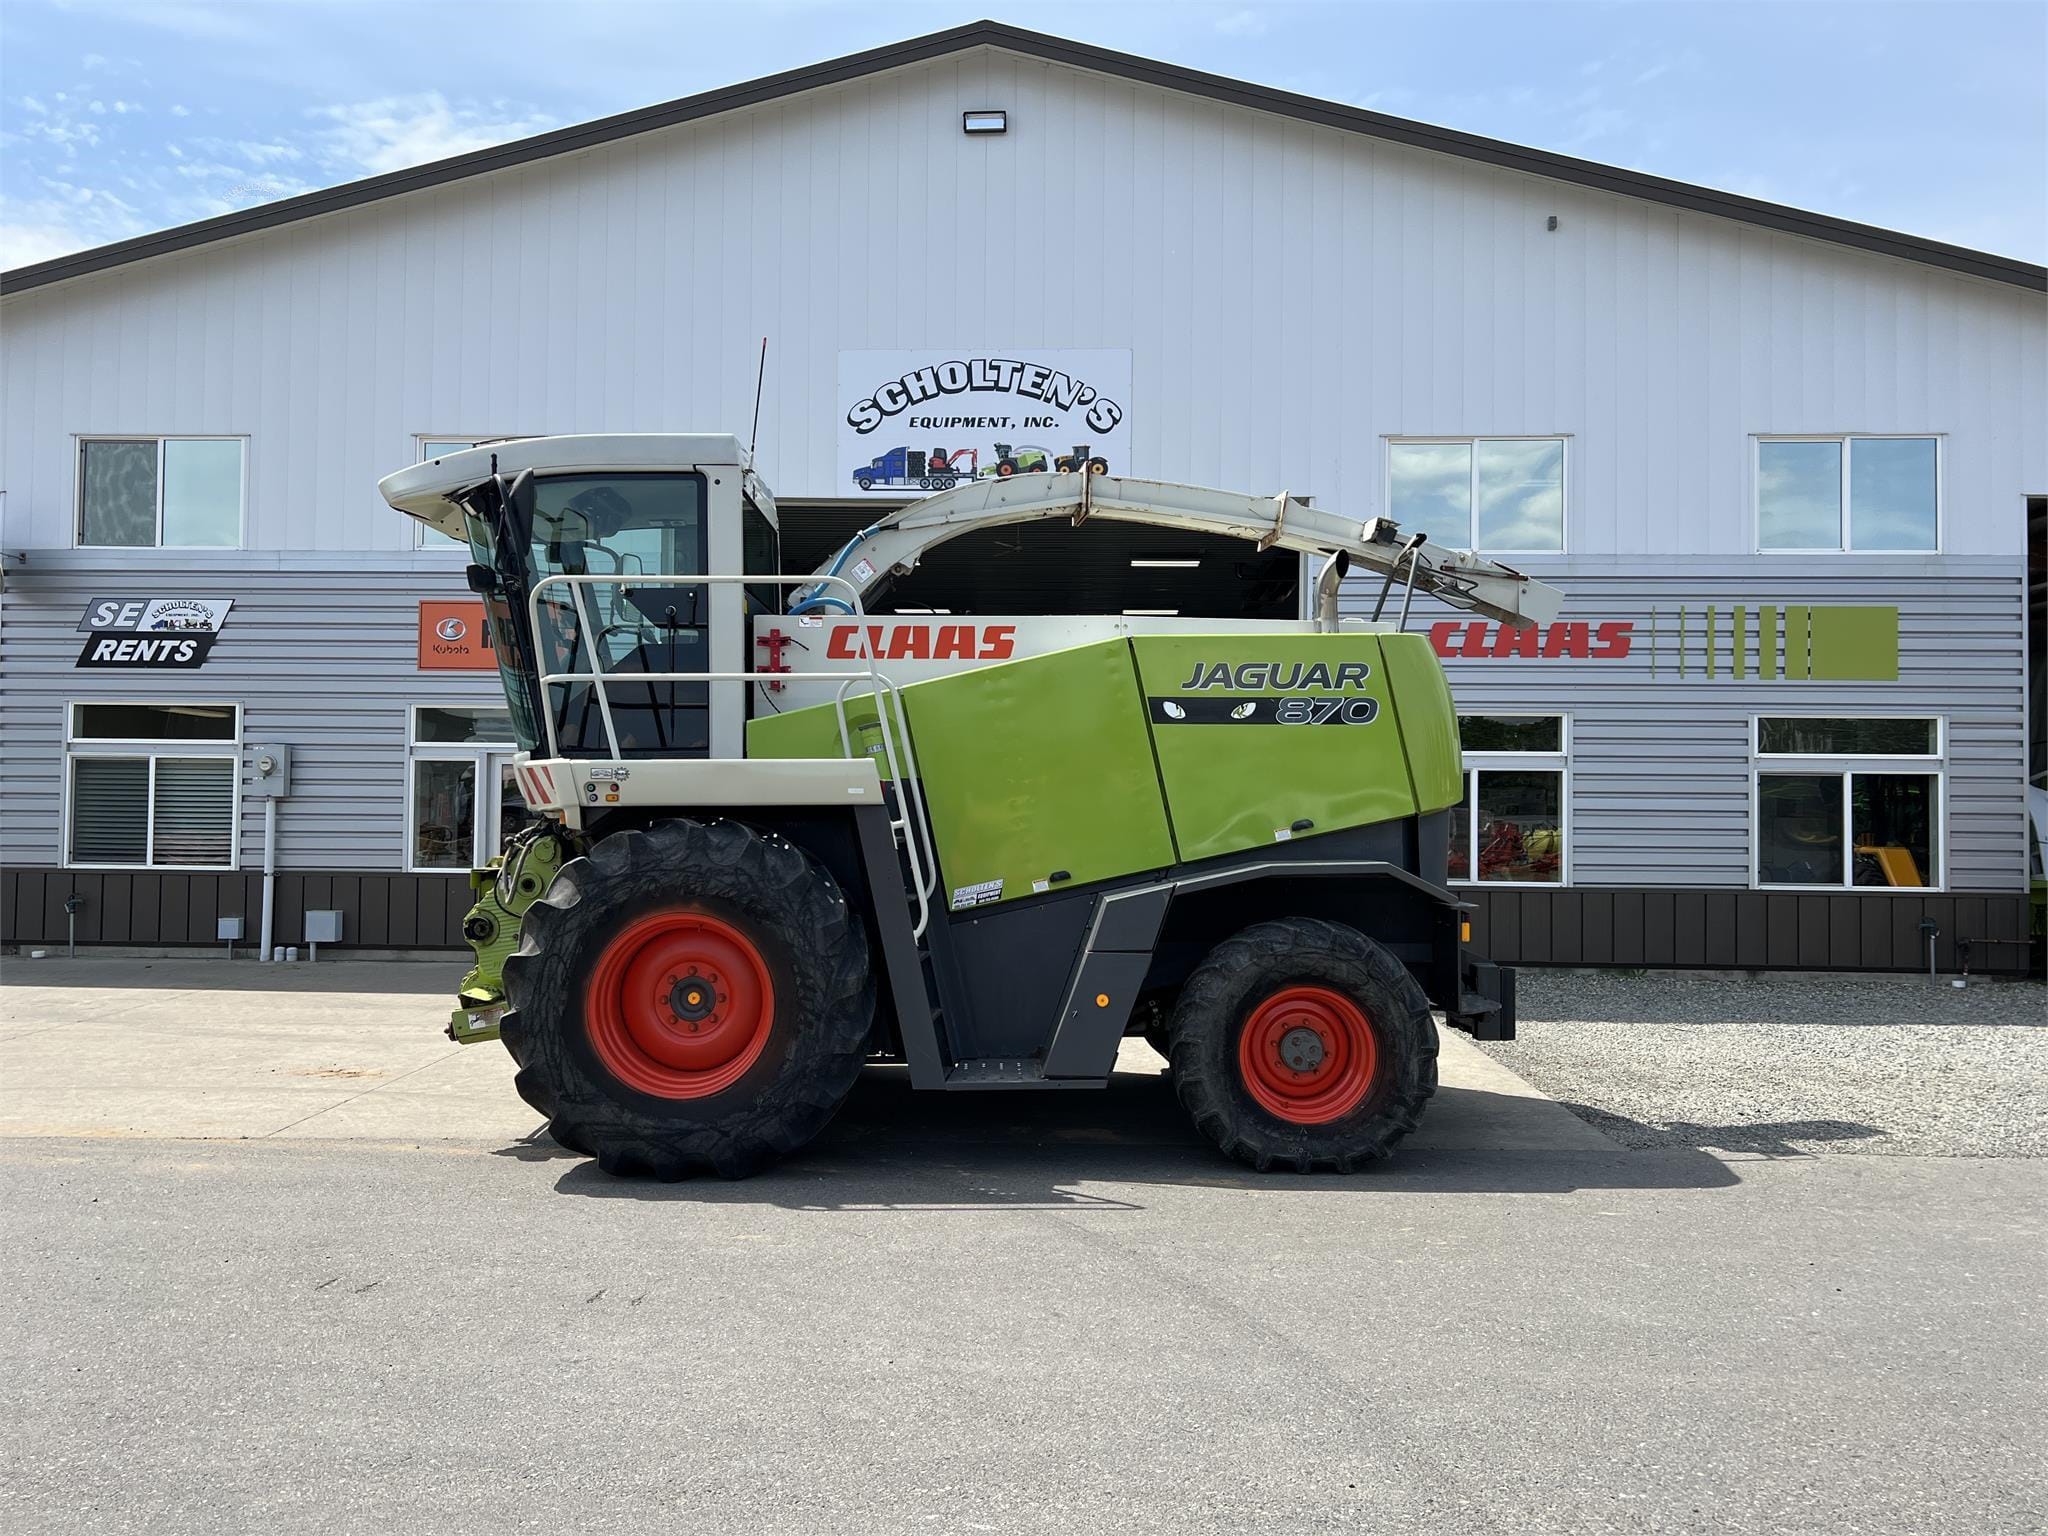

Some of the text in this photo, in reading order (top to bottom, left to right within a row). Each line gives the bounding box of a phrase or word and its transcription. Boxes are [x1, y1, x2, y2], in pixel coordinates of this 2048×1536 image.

[847, 358, 1122, 434] SCHOLTEN'S
[909, 416, 1060, 430] EQUIPMENT, INC.
[90, 602, 145, 627] SE
[91, 639, 198, 662] RENTS
[432, 644, 470, 654] Kubota
[826, 625, 1016, 660] CLAAS
[1429, 622, 1634, 659] CLAAS
[1181, 661, 1371, 691] JAGUAR
[1276, 697, 1380, 725] 870
